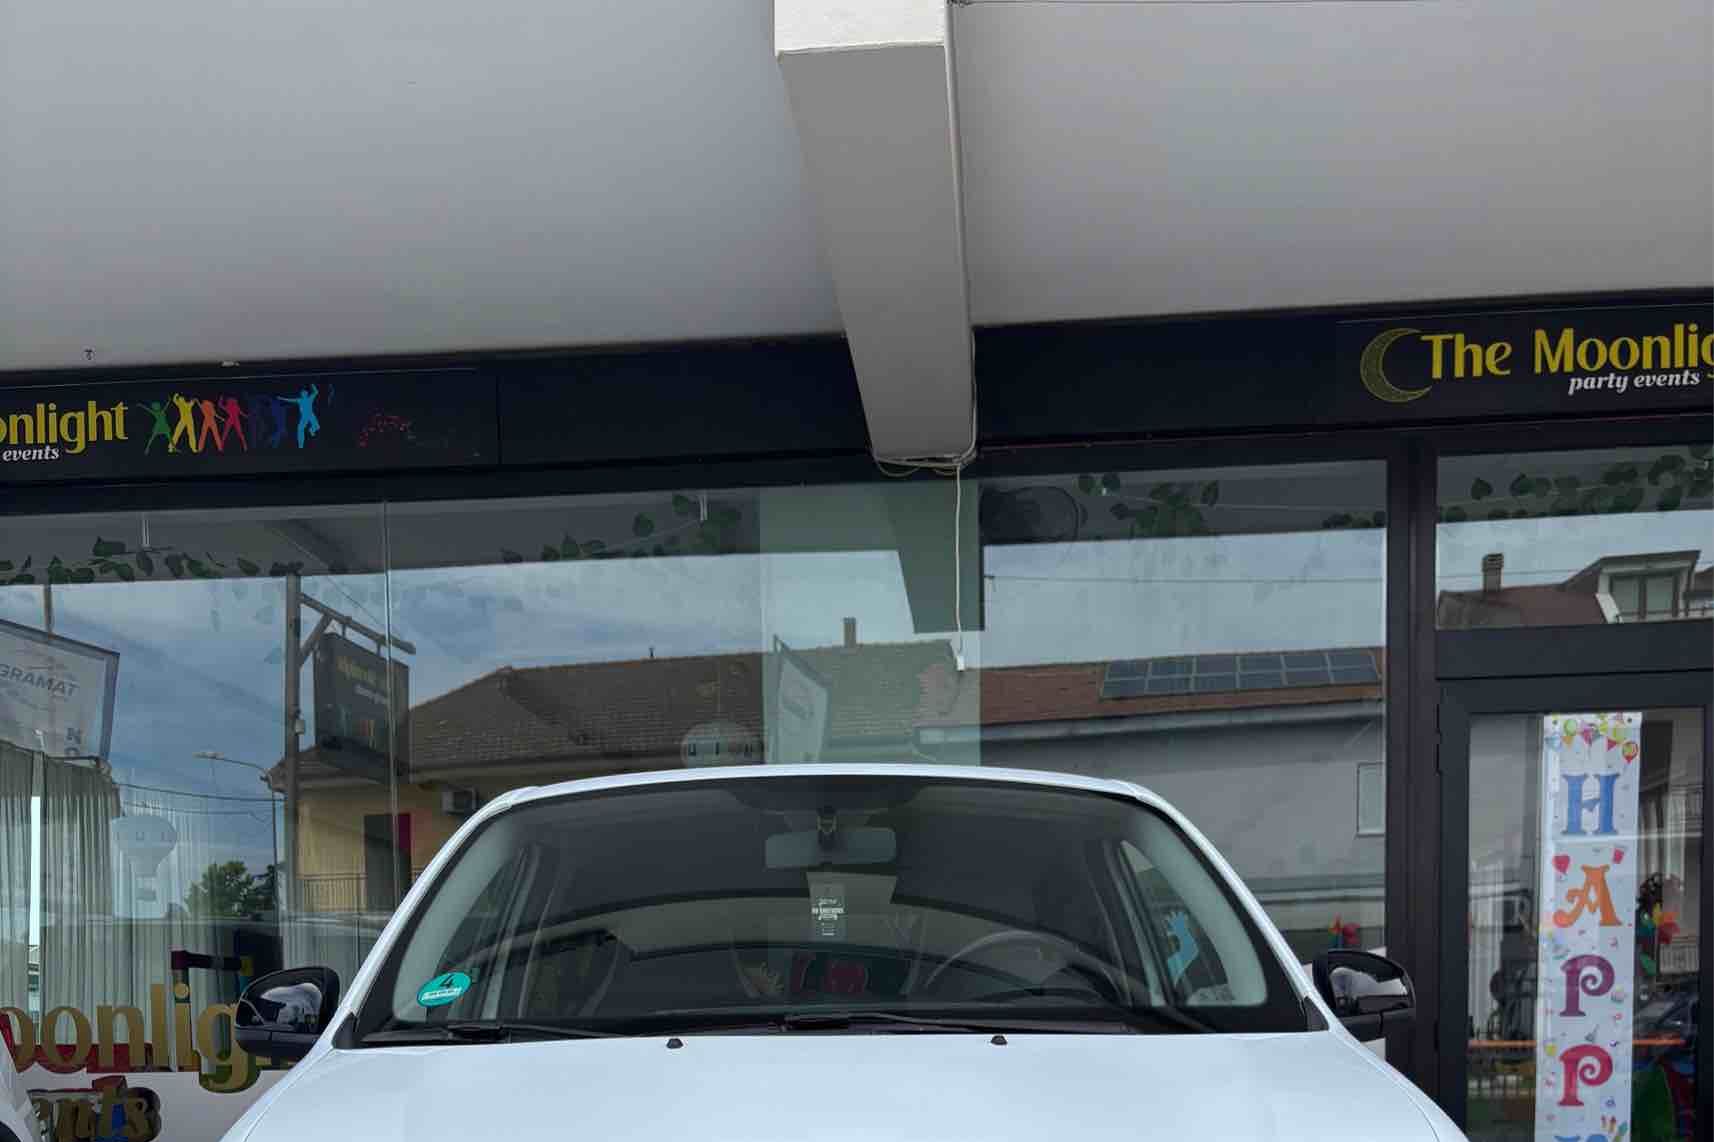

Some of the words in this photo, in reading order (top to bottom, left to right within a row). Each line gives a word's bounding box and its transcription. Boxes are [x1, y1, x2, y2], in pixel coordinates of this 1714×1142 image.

[1421, 332, 1512, 379] The
[1568, 372, 1628, 396] party
[1633, 370, 1701, 388] events
[0, 400, 128, 455] nlight
[2, 445, 60, 462] events
